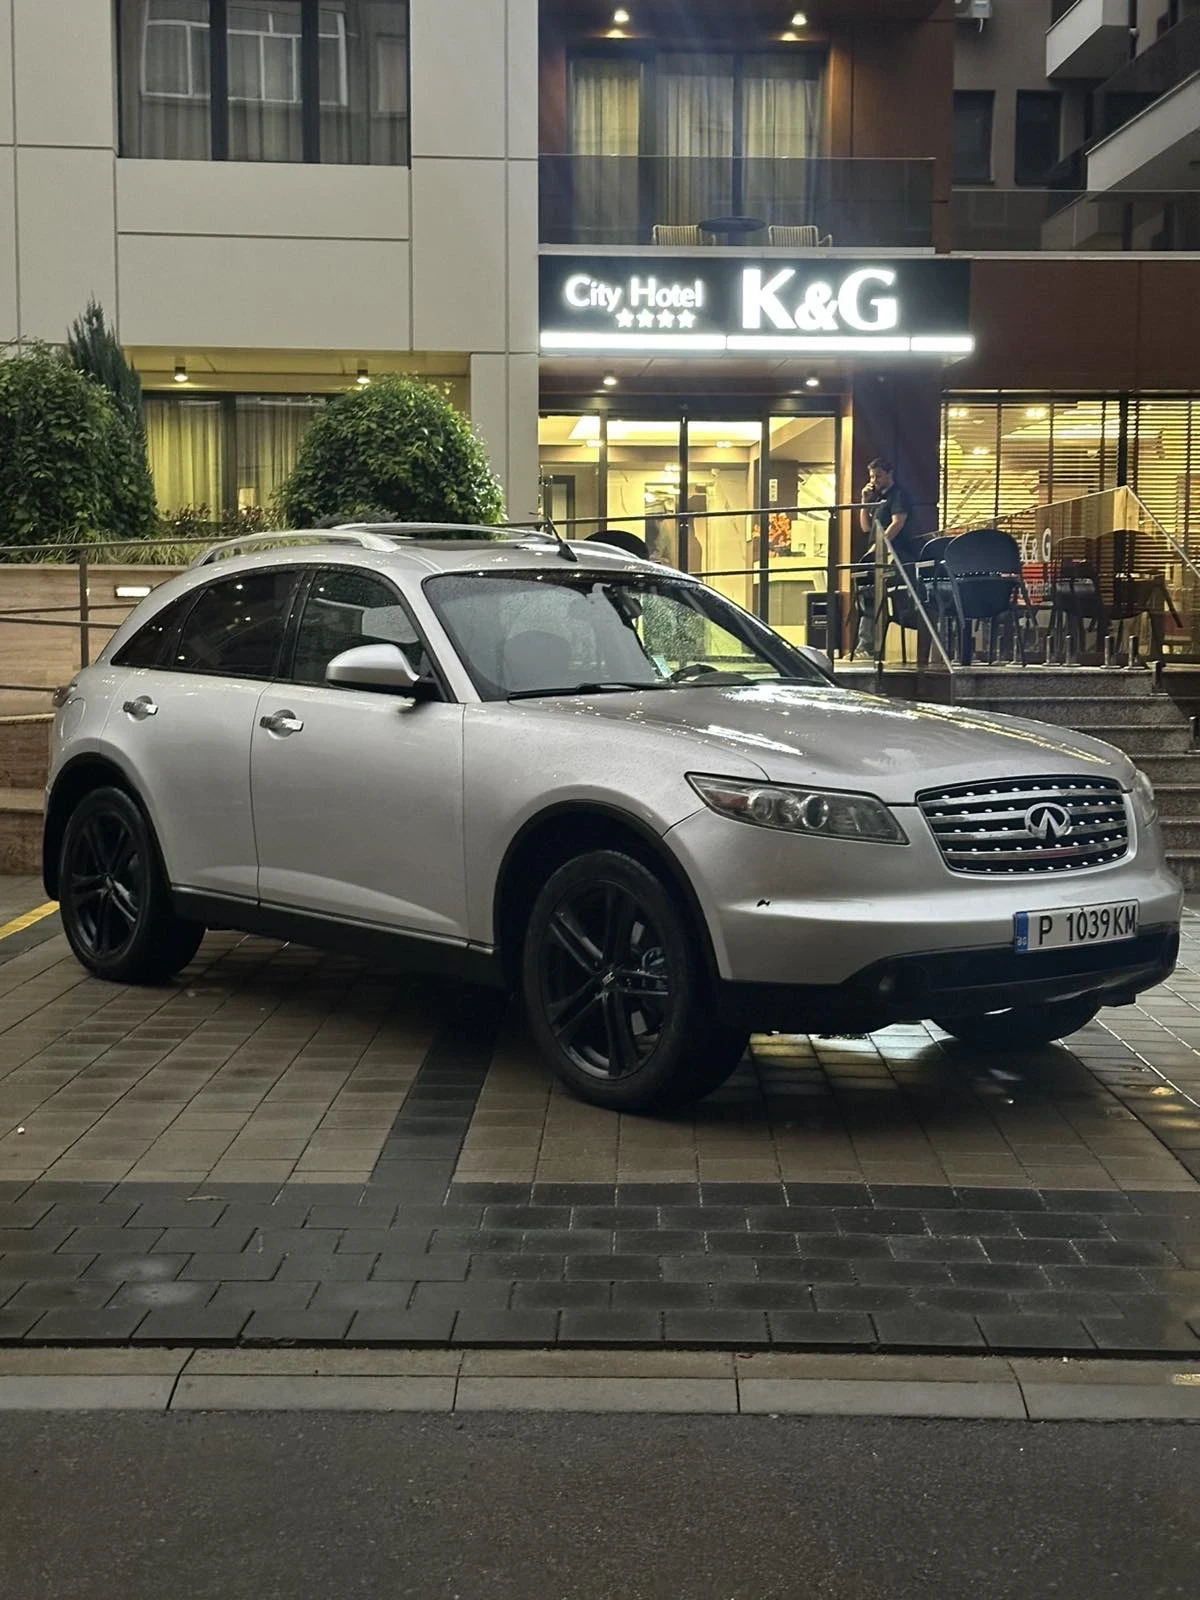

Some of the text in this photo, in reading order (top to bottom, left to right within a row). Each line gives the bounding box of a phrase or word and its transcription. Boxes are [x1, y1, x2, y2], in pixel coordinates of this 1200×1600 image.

[565, 275, 704, 313] City Hotel
[741, 267, 899, 332] K&G
[1039, 915, 1053, 945] P
